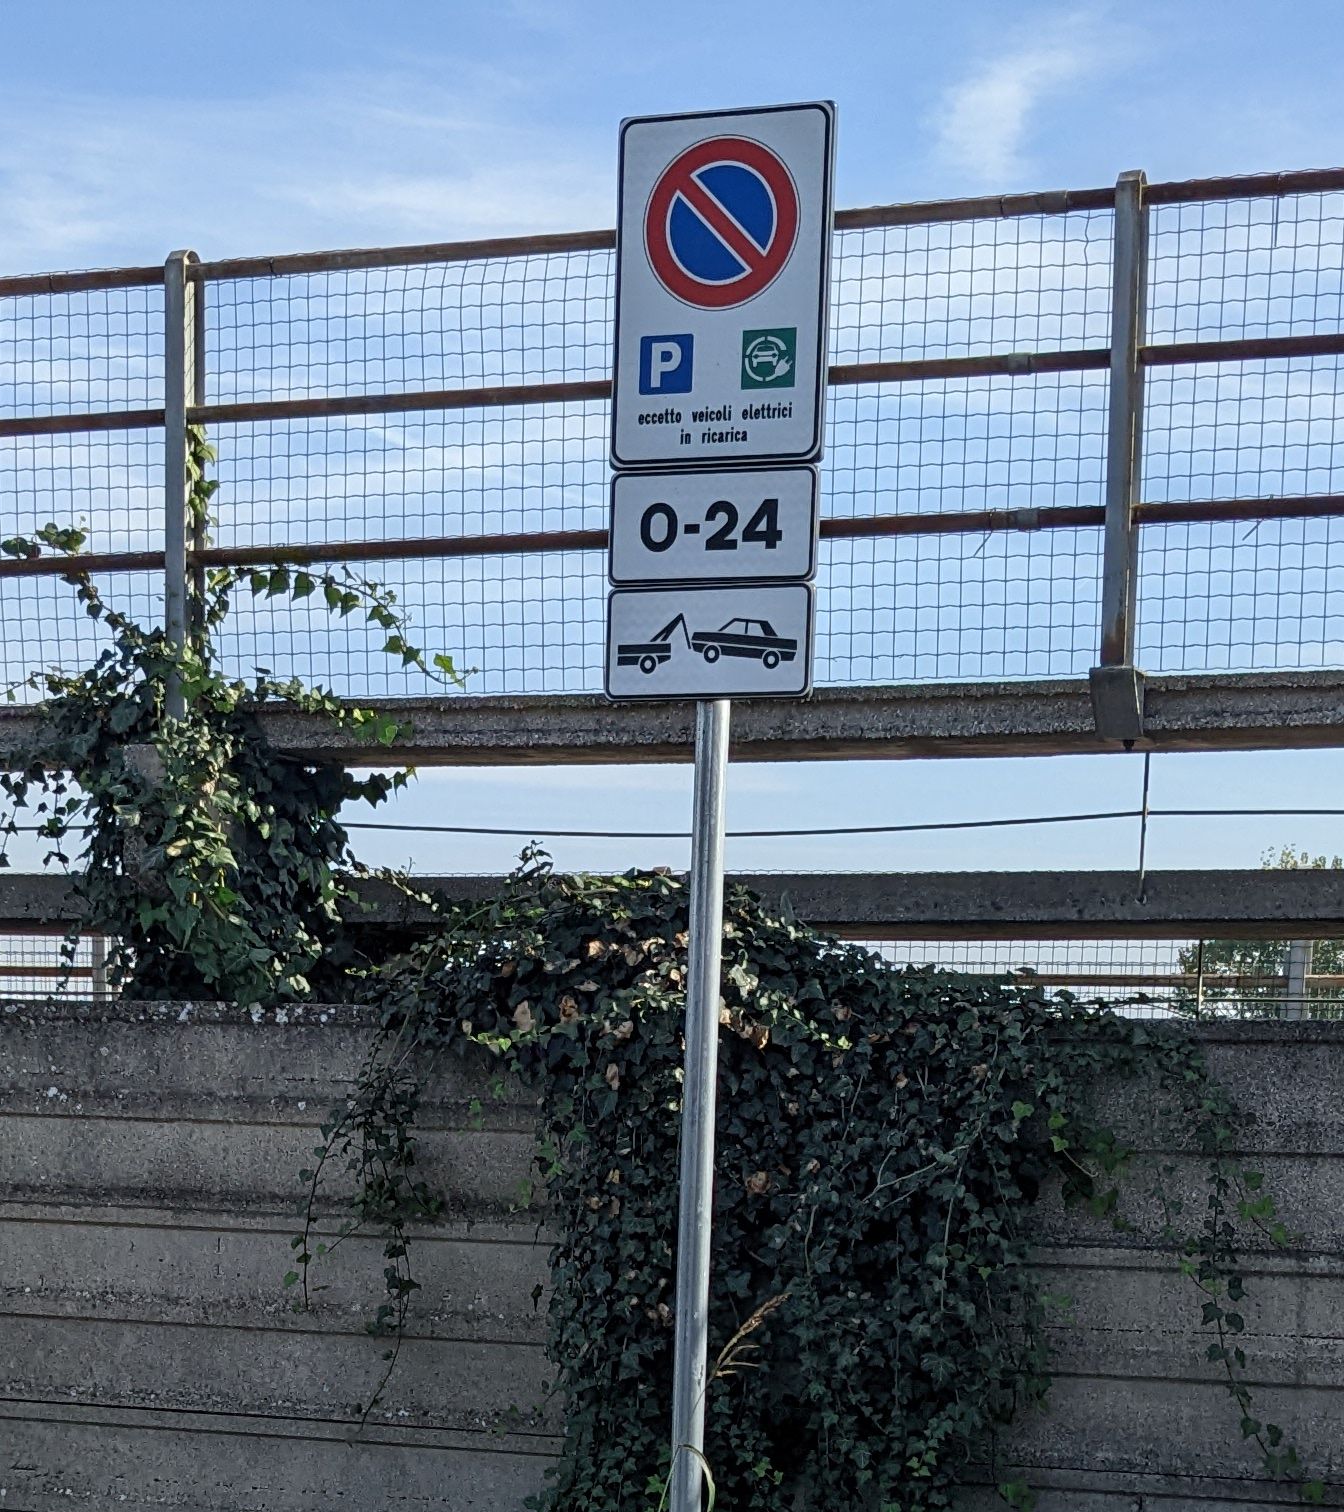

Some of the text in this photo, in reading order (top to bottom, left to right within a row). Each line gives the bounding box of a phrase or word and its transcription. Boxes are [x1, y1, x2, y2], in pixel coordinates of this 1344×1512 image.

[650, 341, 682, 388] P
[638, 402, 793, 425] eccetto veicoli elettrici
[680, 427, 748, 445] in ricarica
[640, 498, 783, 553] 0-24
